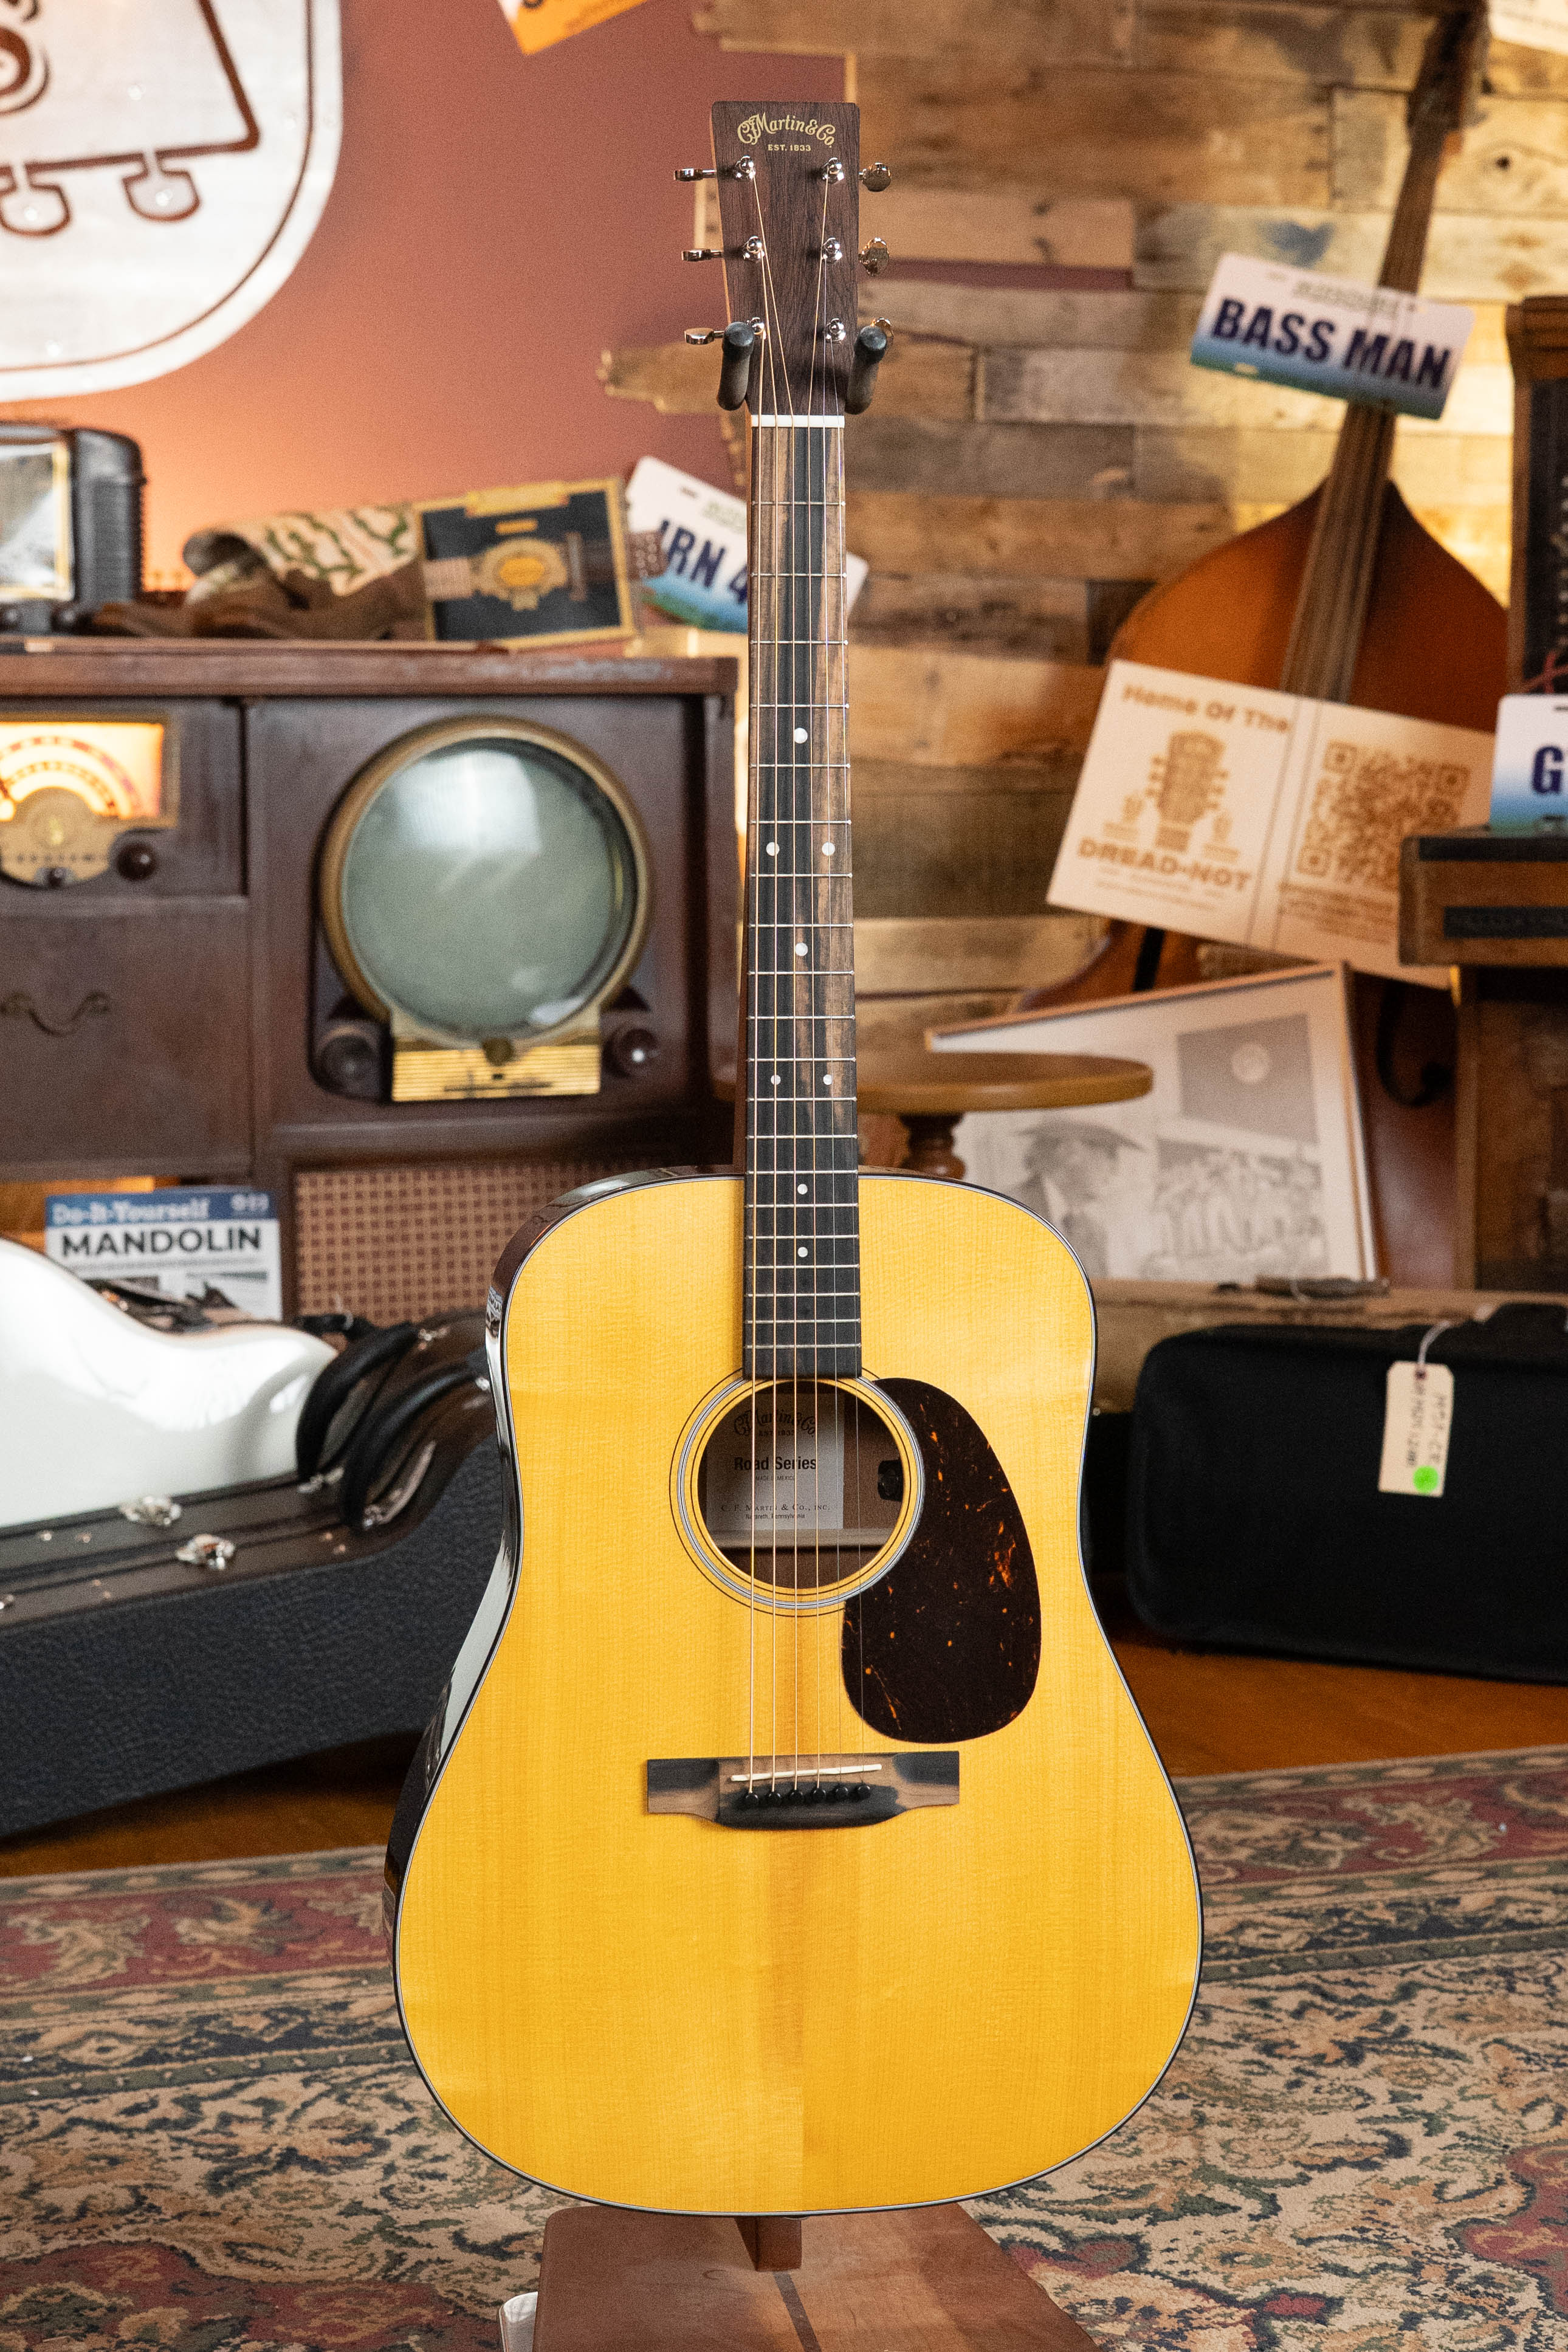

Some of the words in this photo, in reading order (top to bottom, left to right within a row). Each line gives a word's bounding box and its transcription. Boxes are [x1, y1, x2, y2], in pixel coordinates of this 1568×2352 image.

[1213, 297, 1336, 363] BASS
[1343, 328, 1451, 388] MAN
[1122, 684, 1197, 715] Home
[1205, 699, 1236, 723] Of
[1244, 707, 1290, 733] The
[1078, 836, 1252, 892] DREAD-NOT
[62, 1225, 261, 1257] MANDOLIN
[734, 1456, 769, 1471] Road
[775, 1456, 817, 1470] Series
